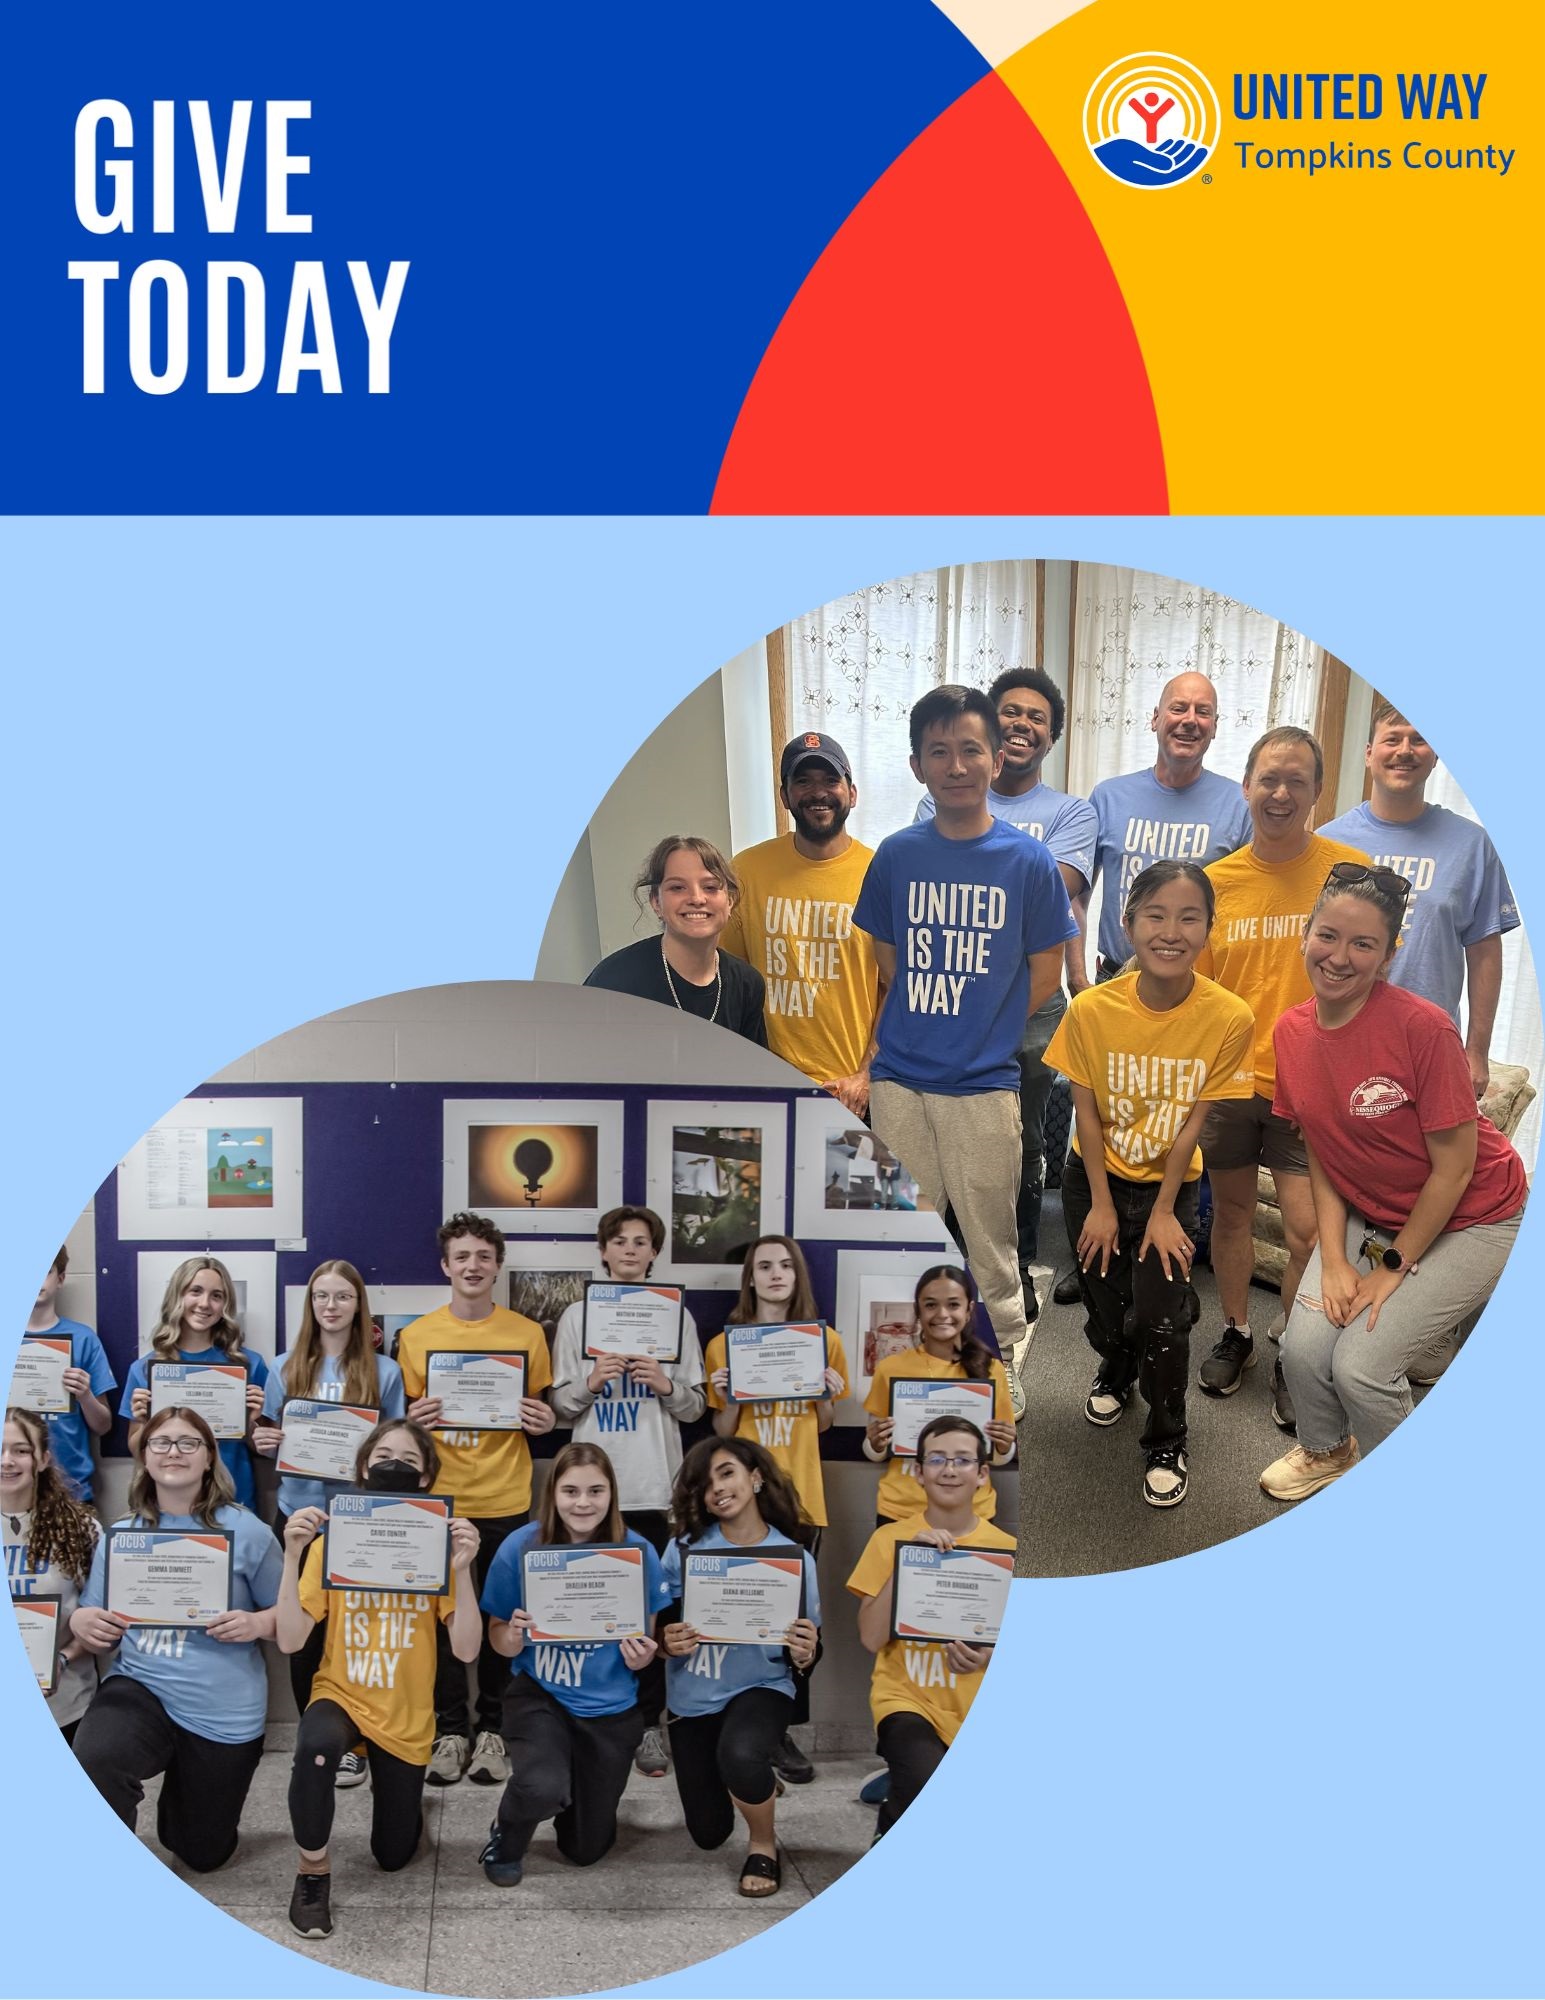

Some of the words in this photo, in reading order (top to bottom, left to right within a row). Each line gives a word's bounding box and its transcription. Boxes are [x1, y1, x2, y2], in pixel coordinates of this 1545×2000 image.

[1124, 817, 1210, 858] UNITED
[765, 895, 854, 940] UNITED
[908, 881, 1007, 930] UNITED
[1227, 917, 1259, 942] LIVE
[1262, 913, 1312, 940] UNITE
[765, 936, 788, 976] IS
[796, 940, 841, 980] THE
[907, 927, 933, 970] IS
[942, 929, 992, 975] THE
[1108, 1051, 1207, 1103] UNITED
[1108, 1094, 1136, 1128] IS
[1143, 1099, 1190, 1142] THE
[591, 1286, 616, 1298] FOCUS
[155, 1366, 180, 1378] FOCUS
[432, 1355, 458, 1366] FOCUS
[897, 1383, 924, 1395] FOCUS
[594, 1401, 640, 1432] WAY
[755, 1416, 795, 1447] WAY
[334, 1496, 365, 1512] FOCUS
[114, 1534, 146, 1549] FOCUS
[903, 1548, 934, 1563] FOCUS
[148, 1565, 168, 1573] GEMMA
[528, 1552, 560, 1567] FOCUS
[689, 1557, 720, 1571] FOCUS
[936, 1580, 951, 1588] PETER
[136, 1629, 188, 1658] WAY
[345, 1612, 369, 1648] IS
[378, 1612, 418, 1649] THE
[345, 1649, 401, 1689] WAY
[535, 1645, 586, 1687] WAY
